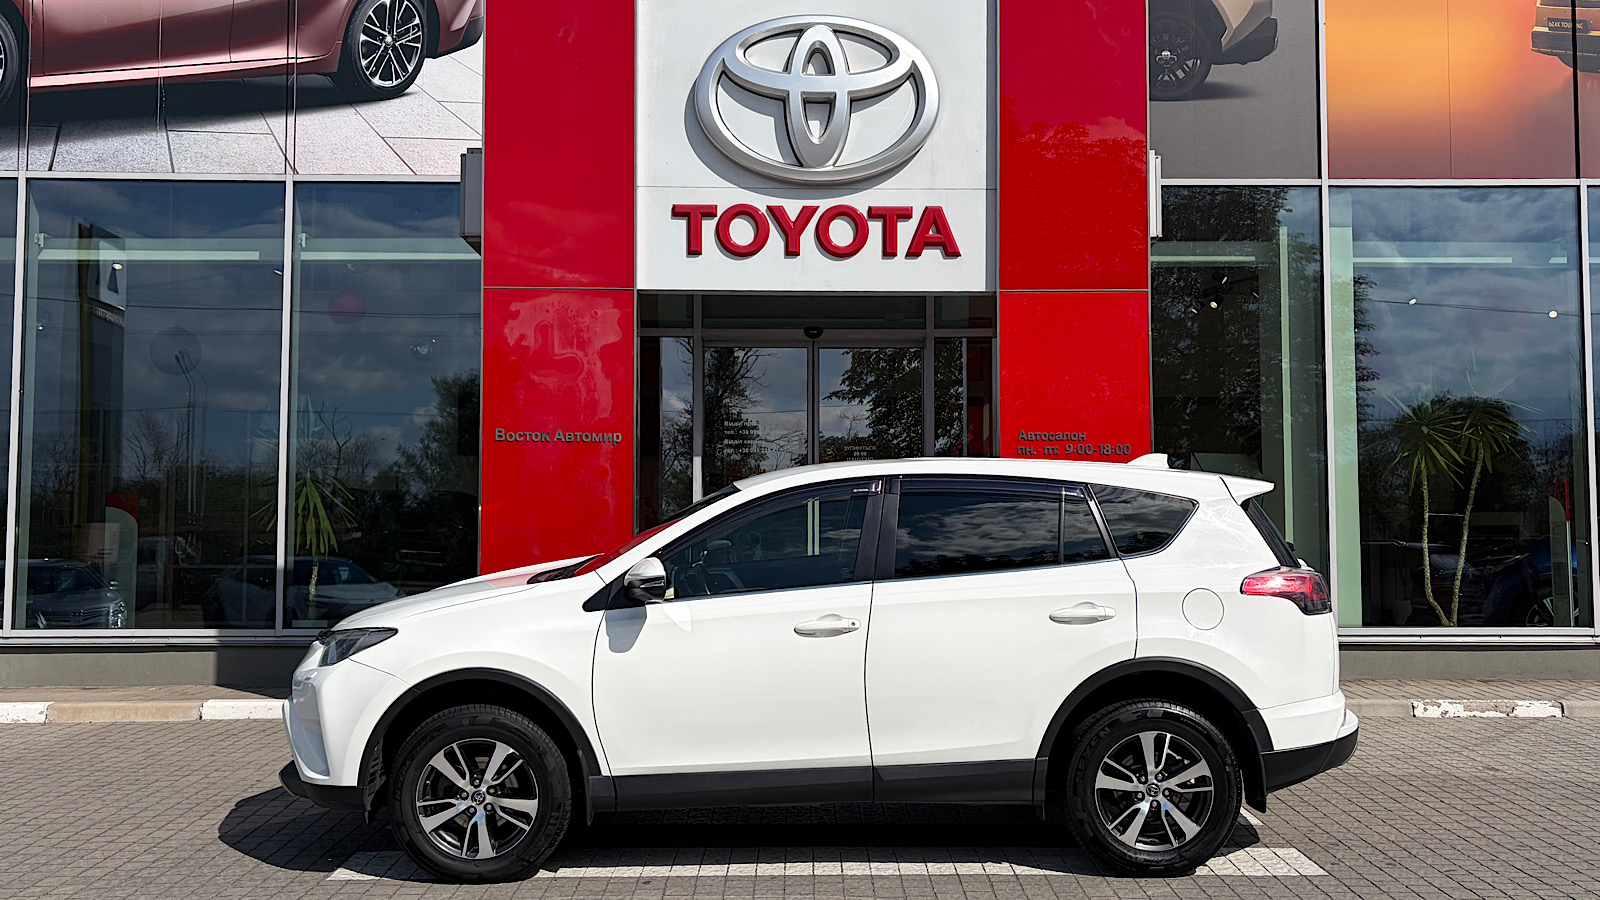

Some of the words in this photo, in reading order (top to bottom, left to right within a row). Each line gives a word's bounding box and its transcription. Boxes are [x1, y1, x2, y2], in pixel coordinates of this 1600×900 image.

[672, 203, 962, 258] TOYOTA
[495, 428, 551, 441] Восток
[553, 429, 623, 446] Автомир
[1018, 429, 1087, 441] Автосалон
[1065, 444, 1132, 456] 9:00-18:00
